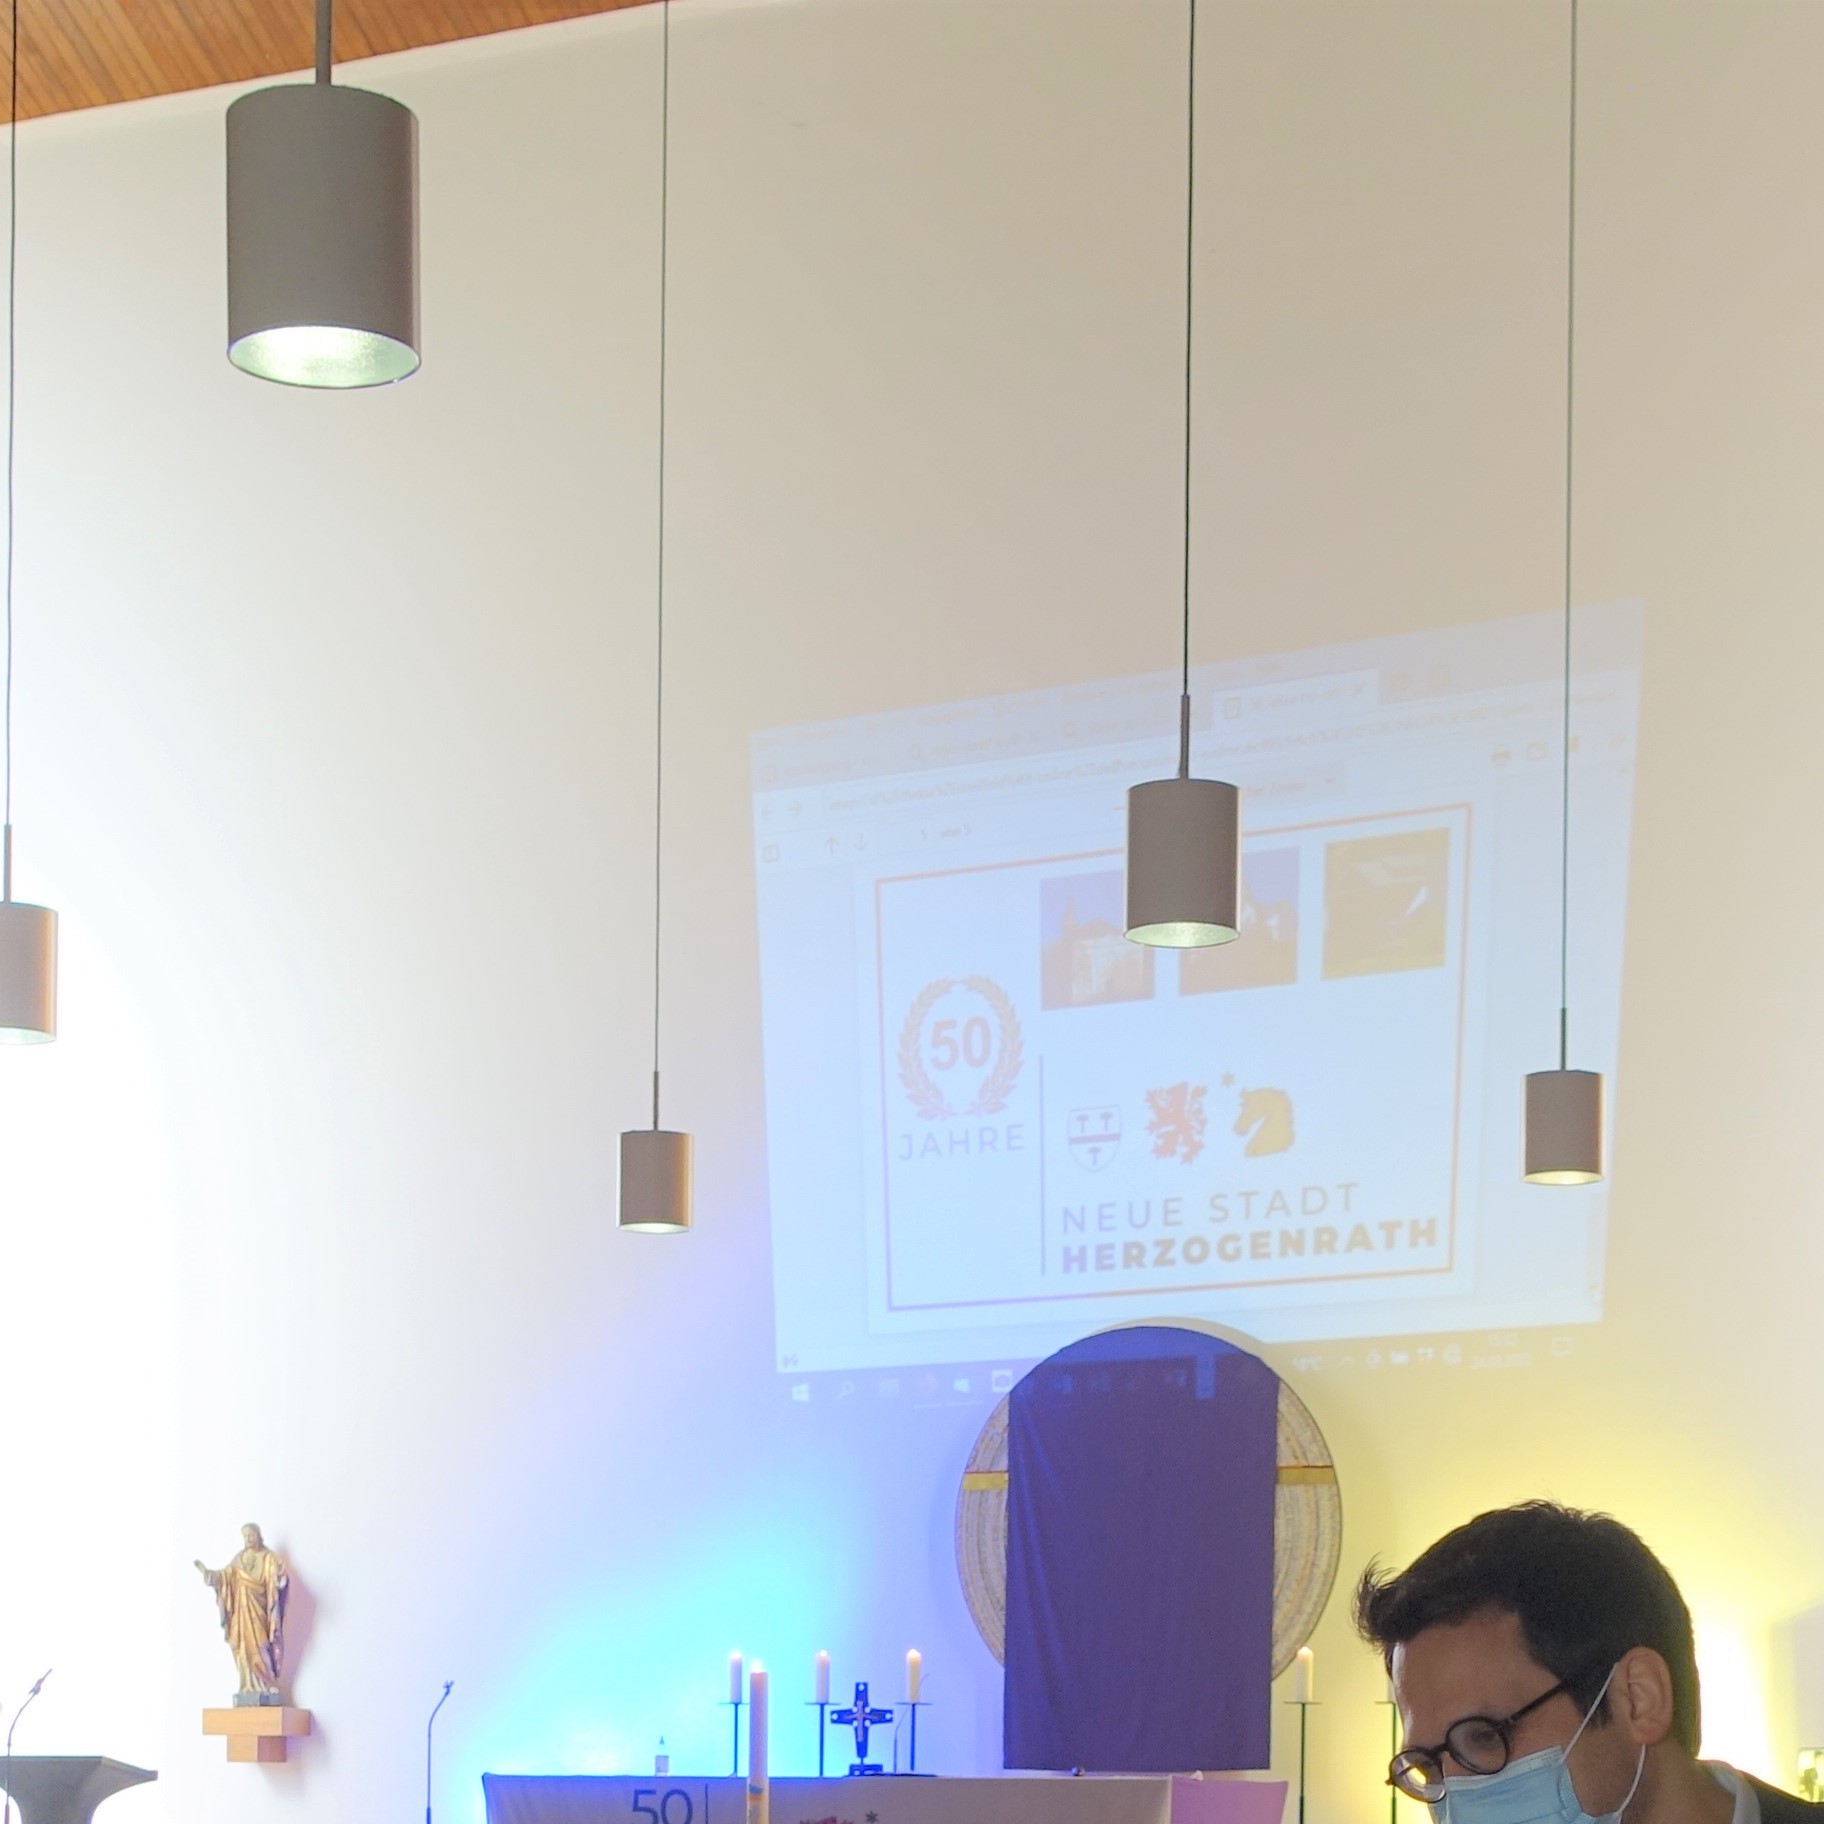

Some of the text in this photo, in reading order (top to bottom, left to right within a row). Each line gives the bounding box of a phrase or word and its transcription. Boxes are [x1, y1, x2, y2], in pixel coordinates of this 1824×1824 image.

[930, 1015, 992, 1072] 50
[898, 1123, 1026, 1161] JAHRE
[1061, 1182, 1360, 1235] NEUE STADT
[1061, 1217, 1438, 1275] HERZOGENRATH
